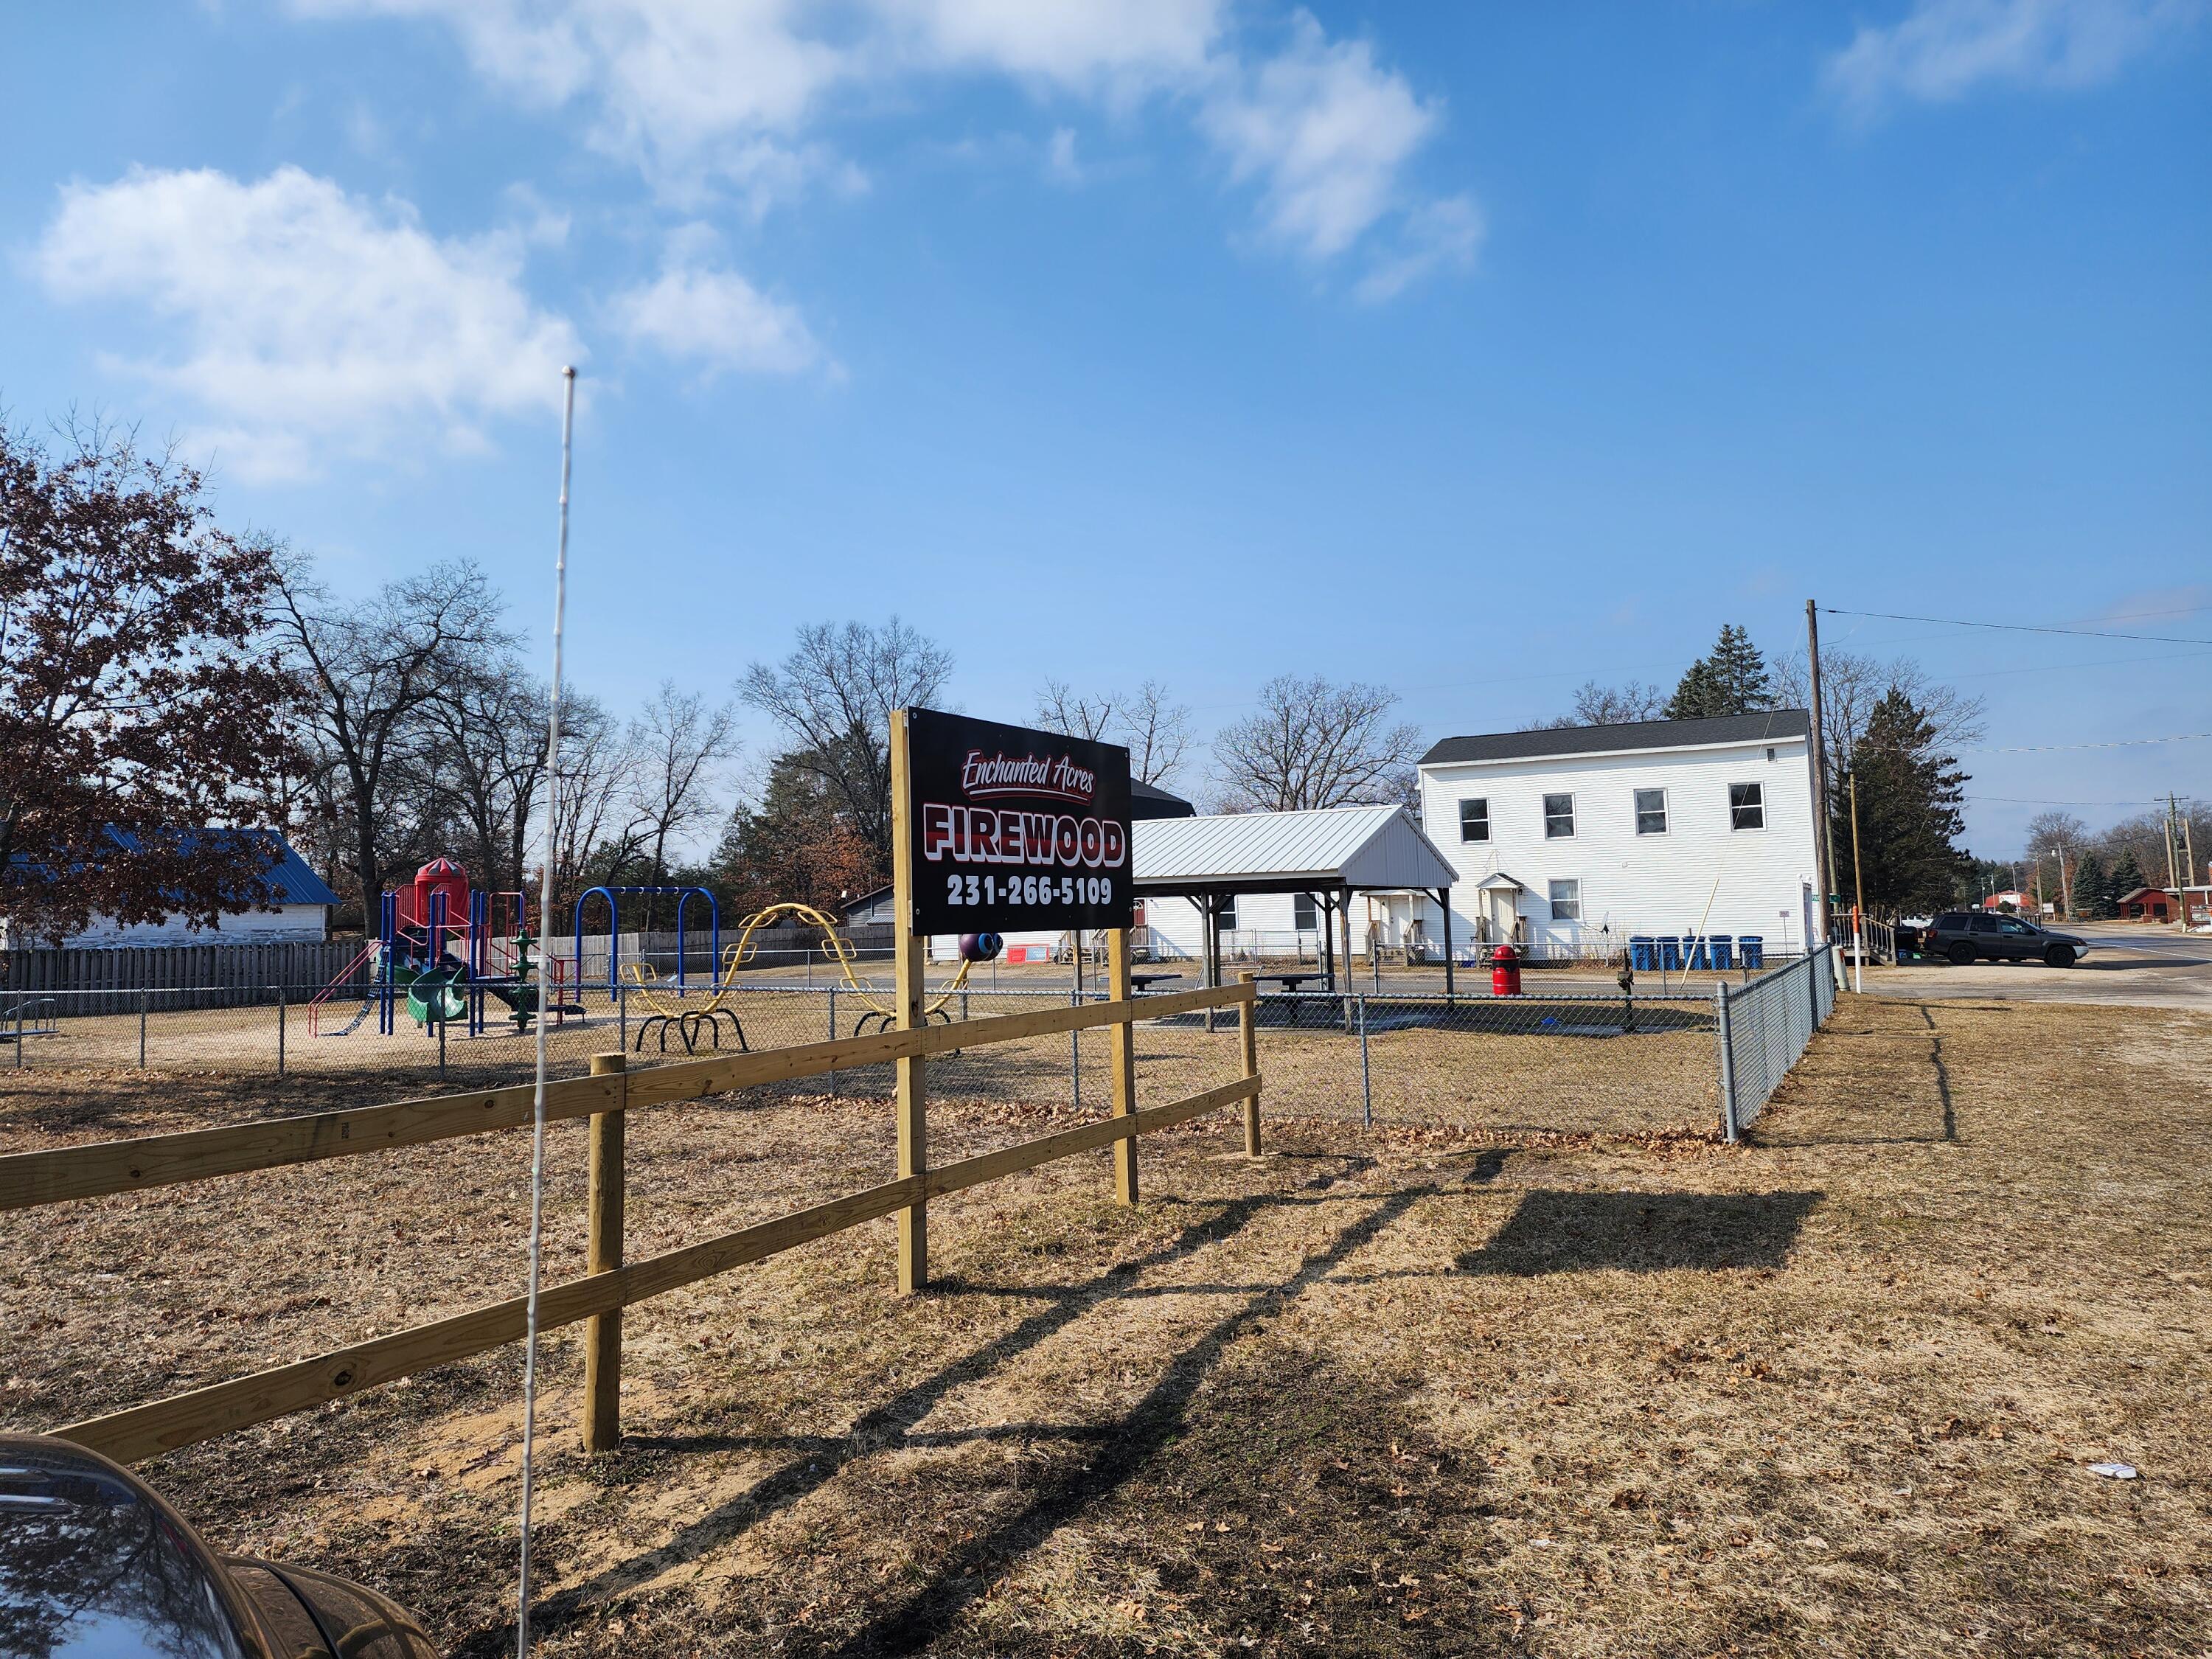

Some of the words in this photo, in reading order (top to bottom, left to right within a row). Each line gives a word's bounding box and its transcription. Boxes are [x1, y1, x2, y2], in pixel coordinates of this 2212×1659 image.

[962, 752, 1051, 789] Enchanted
[1053, 755, 1093, 793] Acres
[923, 803, 1126, 868] FIREWOOD
[947, 874, 1112, 905] 231-266-5109
